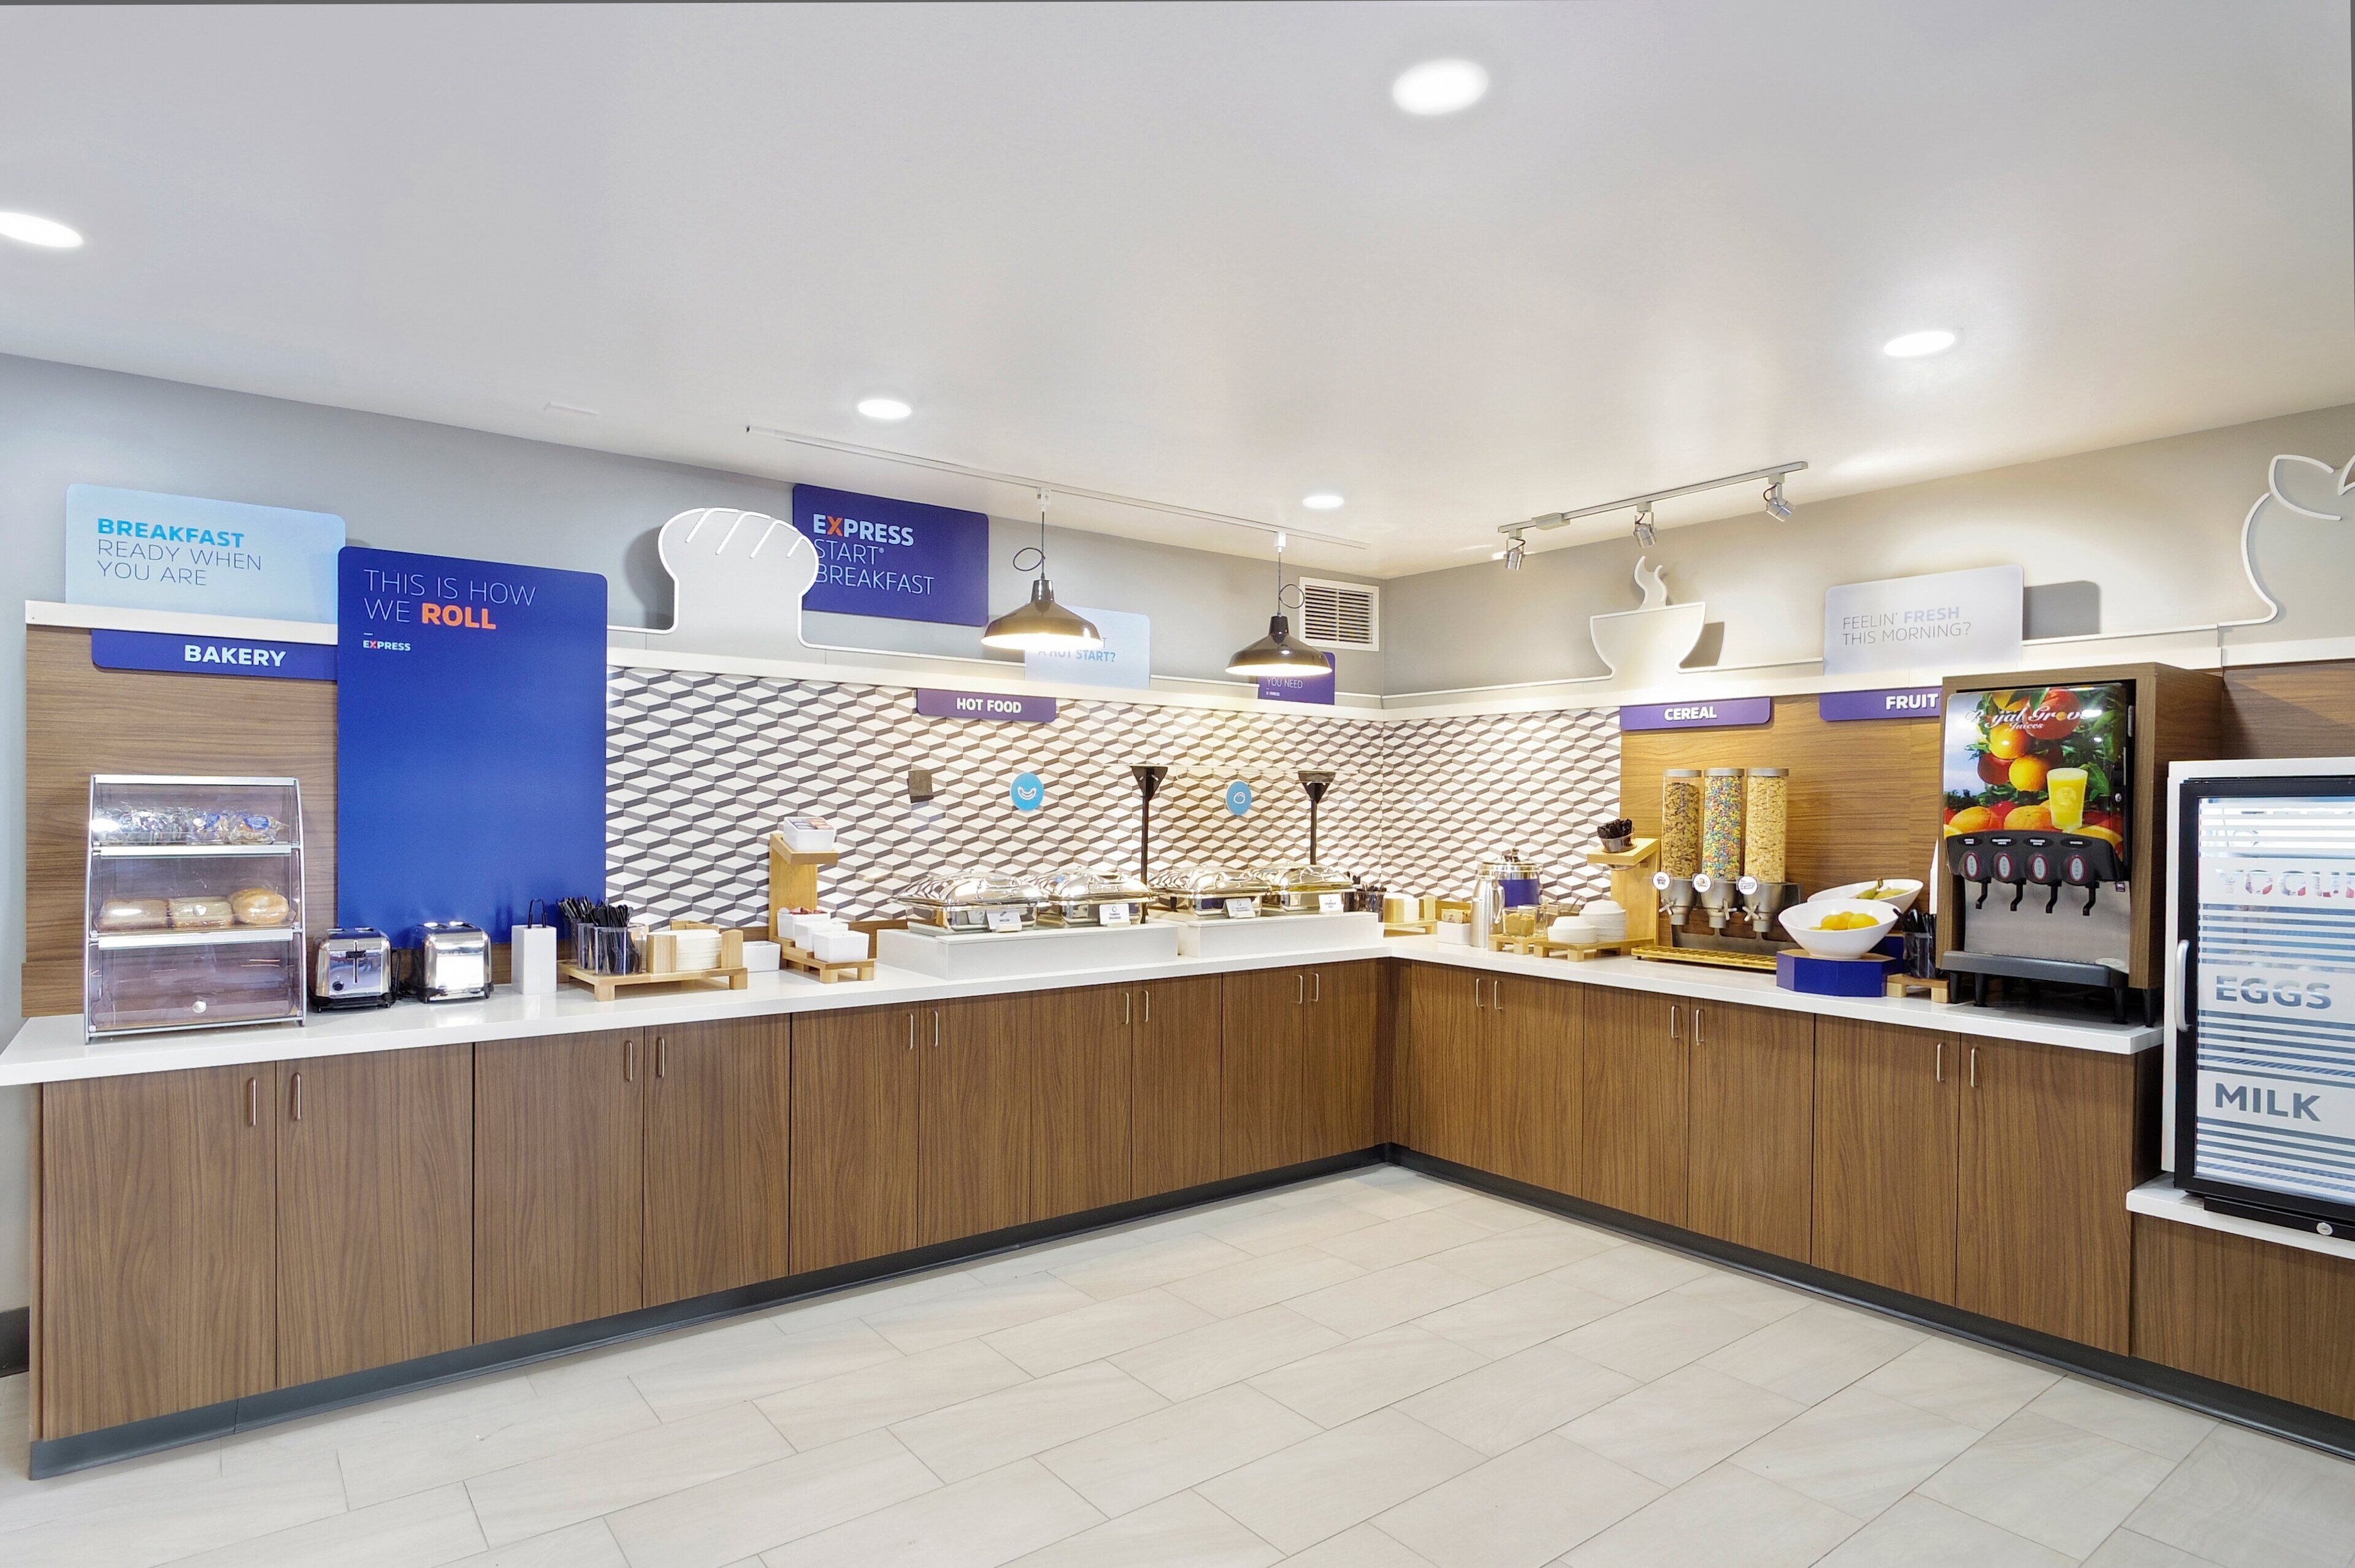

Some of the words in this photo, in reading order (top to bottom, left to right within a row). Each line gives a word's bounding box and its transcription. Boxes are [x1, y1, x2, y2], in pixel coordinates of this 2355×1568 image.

[97, 518, 245, 548] BREAKFAST
[813, 514, 914, 546] EXPRESS
[98, 539, 180, 562] READY
[190, 548, 261, 571] WHEN
[98, 560, 150, 581] YOU
[160, 567, 207, 586] ARE
[814, 563, 935, 595] BREAKFAST
[363, 569, 425, 597] THIS
[437, 576, 458, 600] IS
[470, 580, 536, 606] HOW
[364, 597, 410, 623] WE
[421, 602, 497, 630] ROLL
[1904, 606, 1959, 624] FRESH
[362, 640, 411, 651] EXPRESS
[1842, 630, 1876, 646] THIS
[1882, 622, 1972, 643] MORNING?
[184, 644, 287, 668] BAKERY
[1076, 649, 1116, 663] START?
[1266, 676, 1282, 687] YOU
[1284, 678, 1303, 689] NEED
[956, 697, 984, 711] HOT
[987, 699, 1022, 713] FOOD
[1664, 706, 1717, 721] CEREAL
[1885, 693, 1939, 711] FRUIT
[2005, 721, 2045, 732] Juices
[2216, 975, 2332, 1009] EGGS
[2215, 1082, 2321, 1122] MILK
